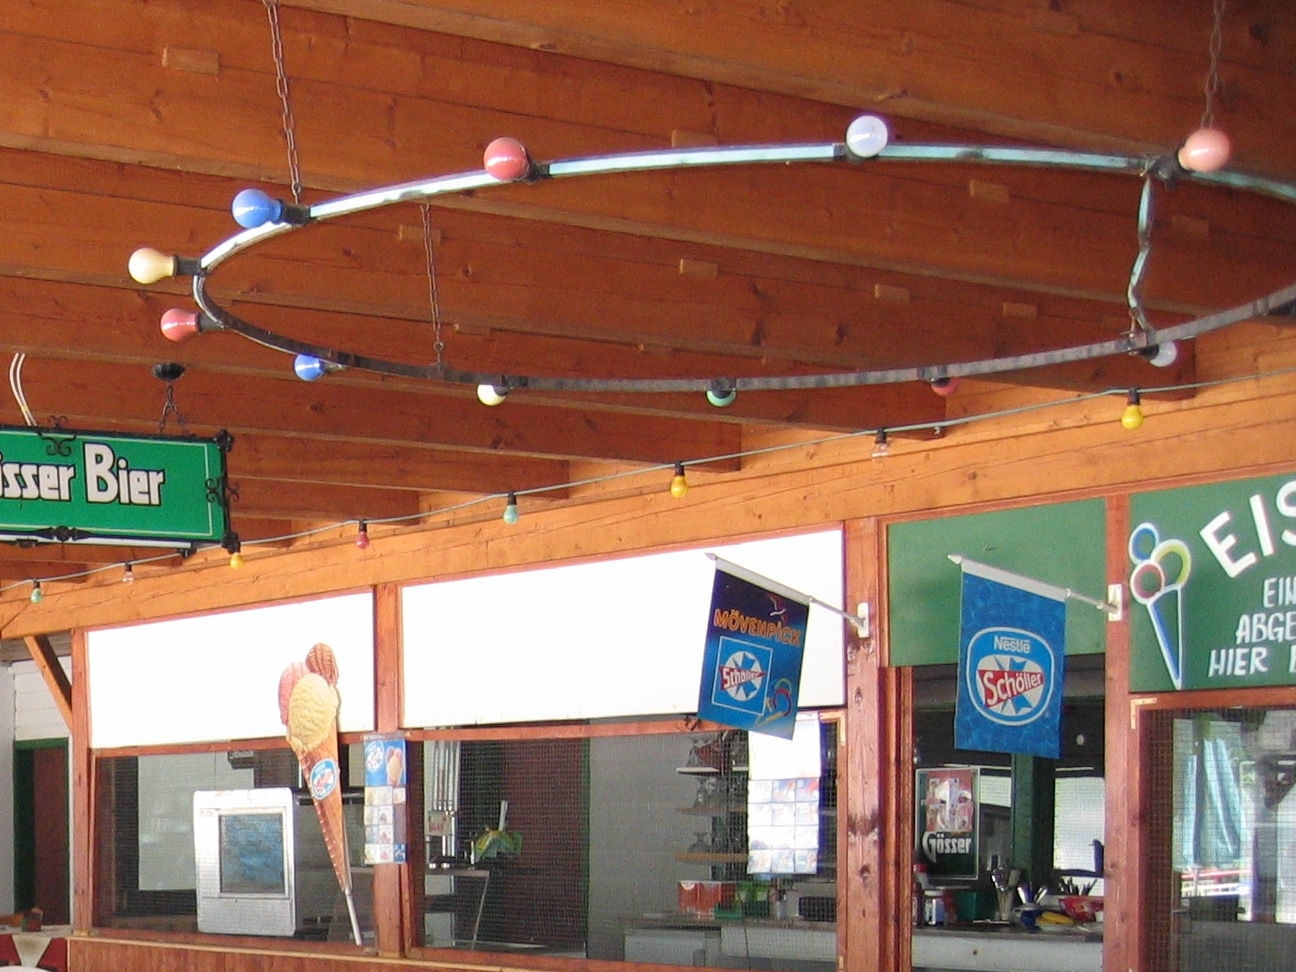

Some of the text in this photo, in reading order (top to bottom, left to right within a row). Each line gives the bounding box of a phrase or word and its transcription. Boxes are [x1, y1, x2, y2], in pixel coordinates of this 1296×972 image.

[83, 442, 166, 506] Bier
[714, 608, 802, 647] MÖVENPICK
[1208, 646, 1268, 677] HIER
[983, 671, 1042, 706] Schöller
[922, 830, 973, 863] Gösser
